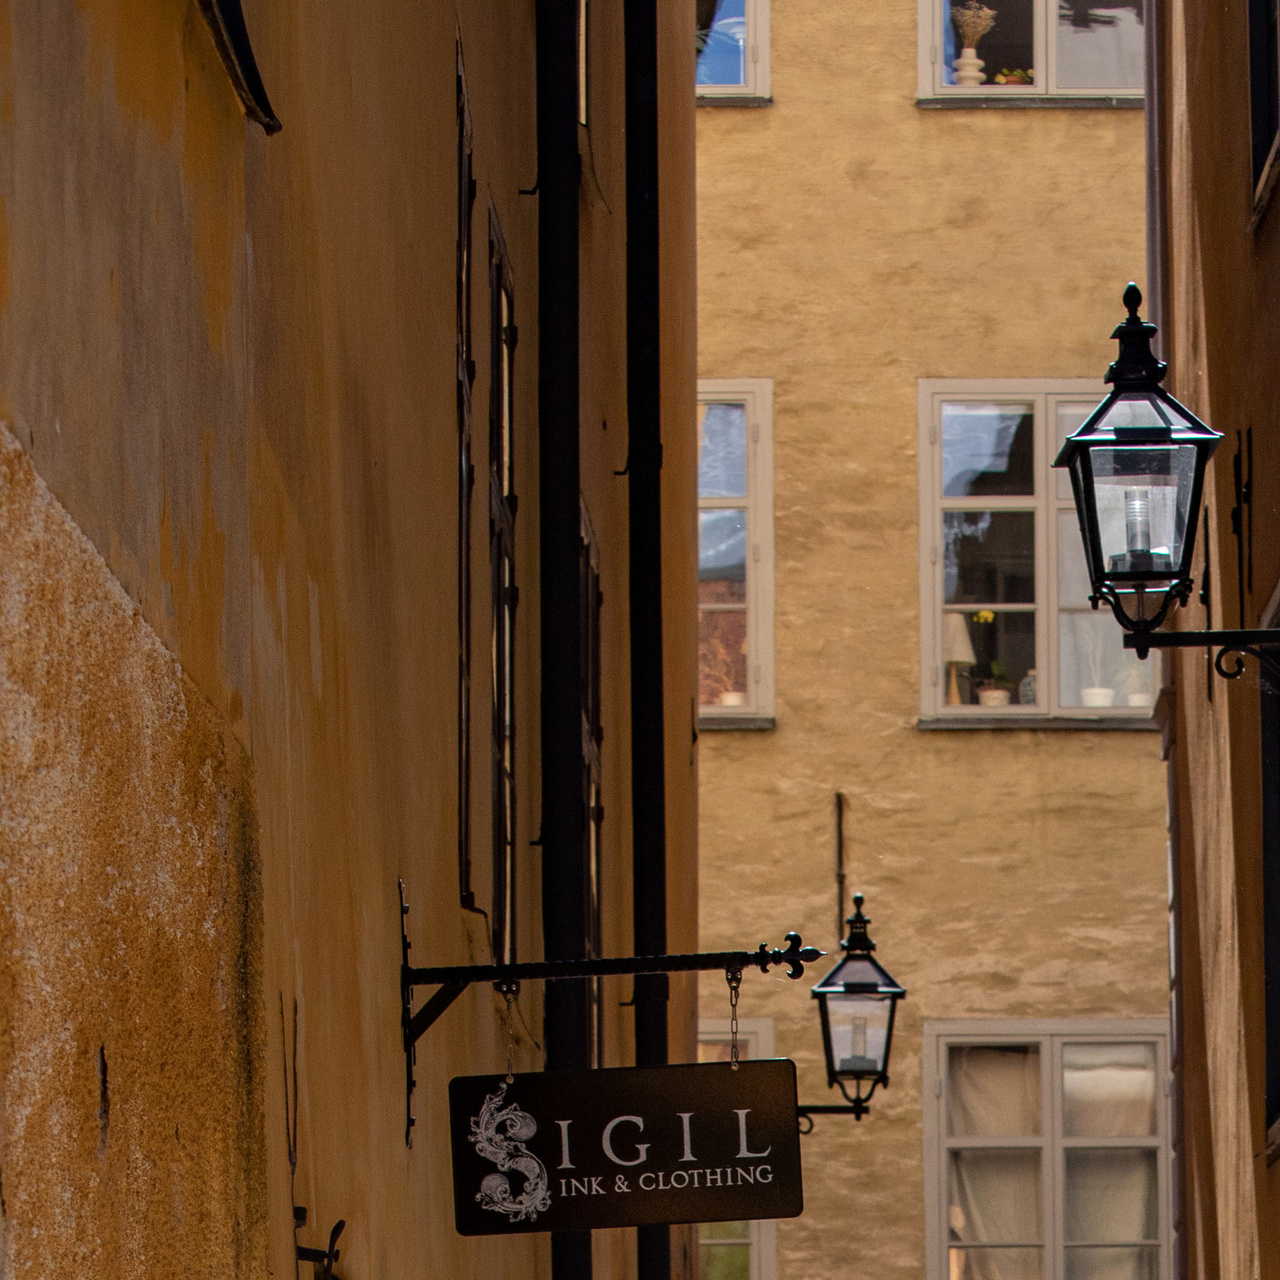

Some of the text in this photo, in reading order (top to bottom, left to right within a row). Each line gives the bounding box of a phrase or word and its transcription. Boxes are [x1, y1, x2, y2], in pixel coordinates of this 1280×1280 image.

[559, 1165, 774, 1197] INK & CLOTHING
